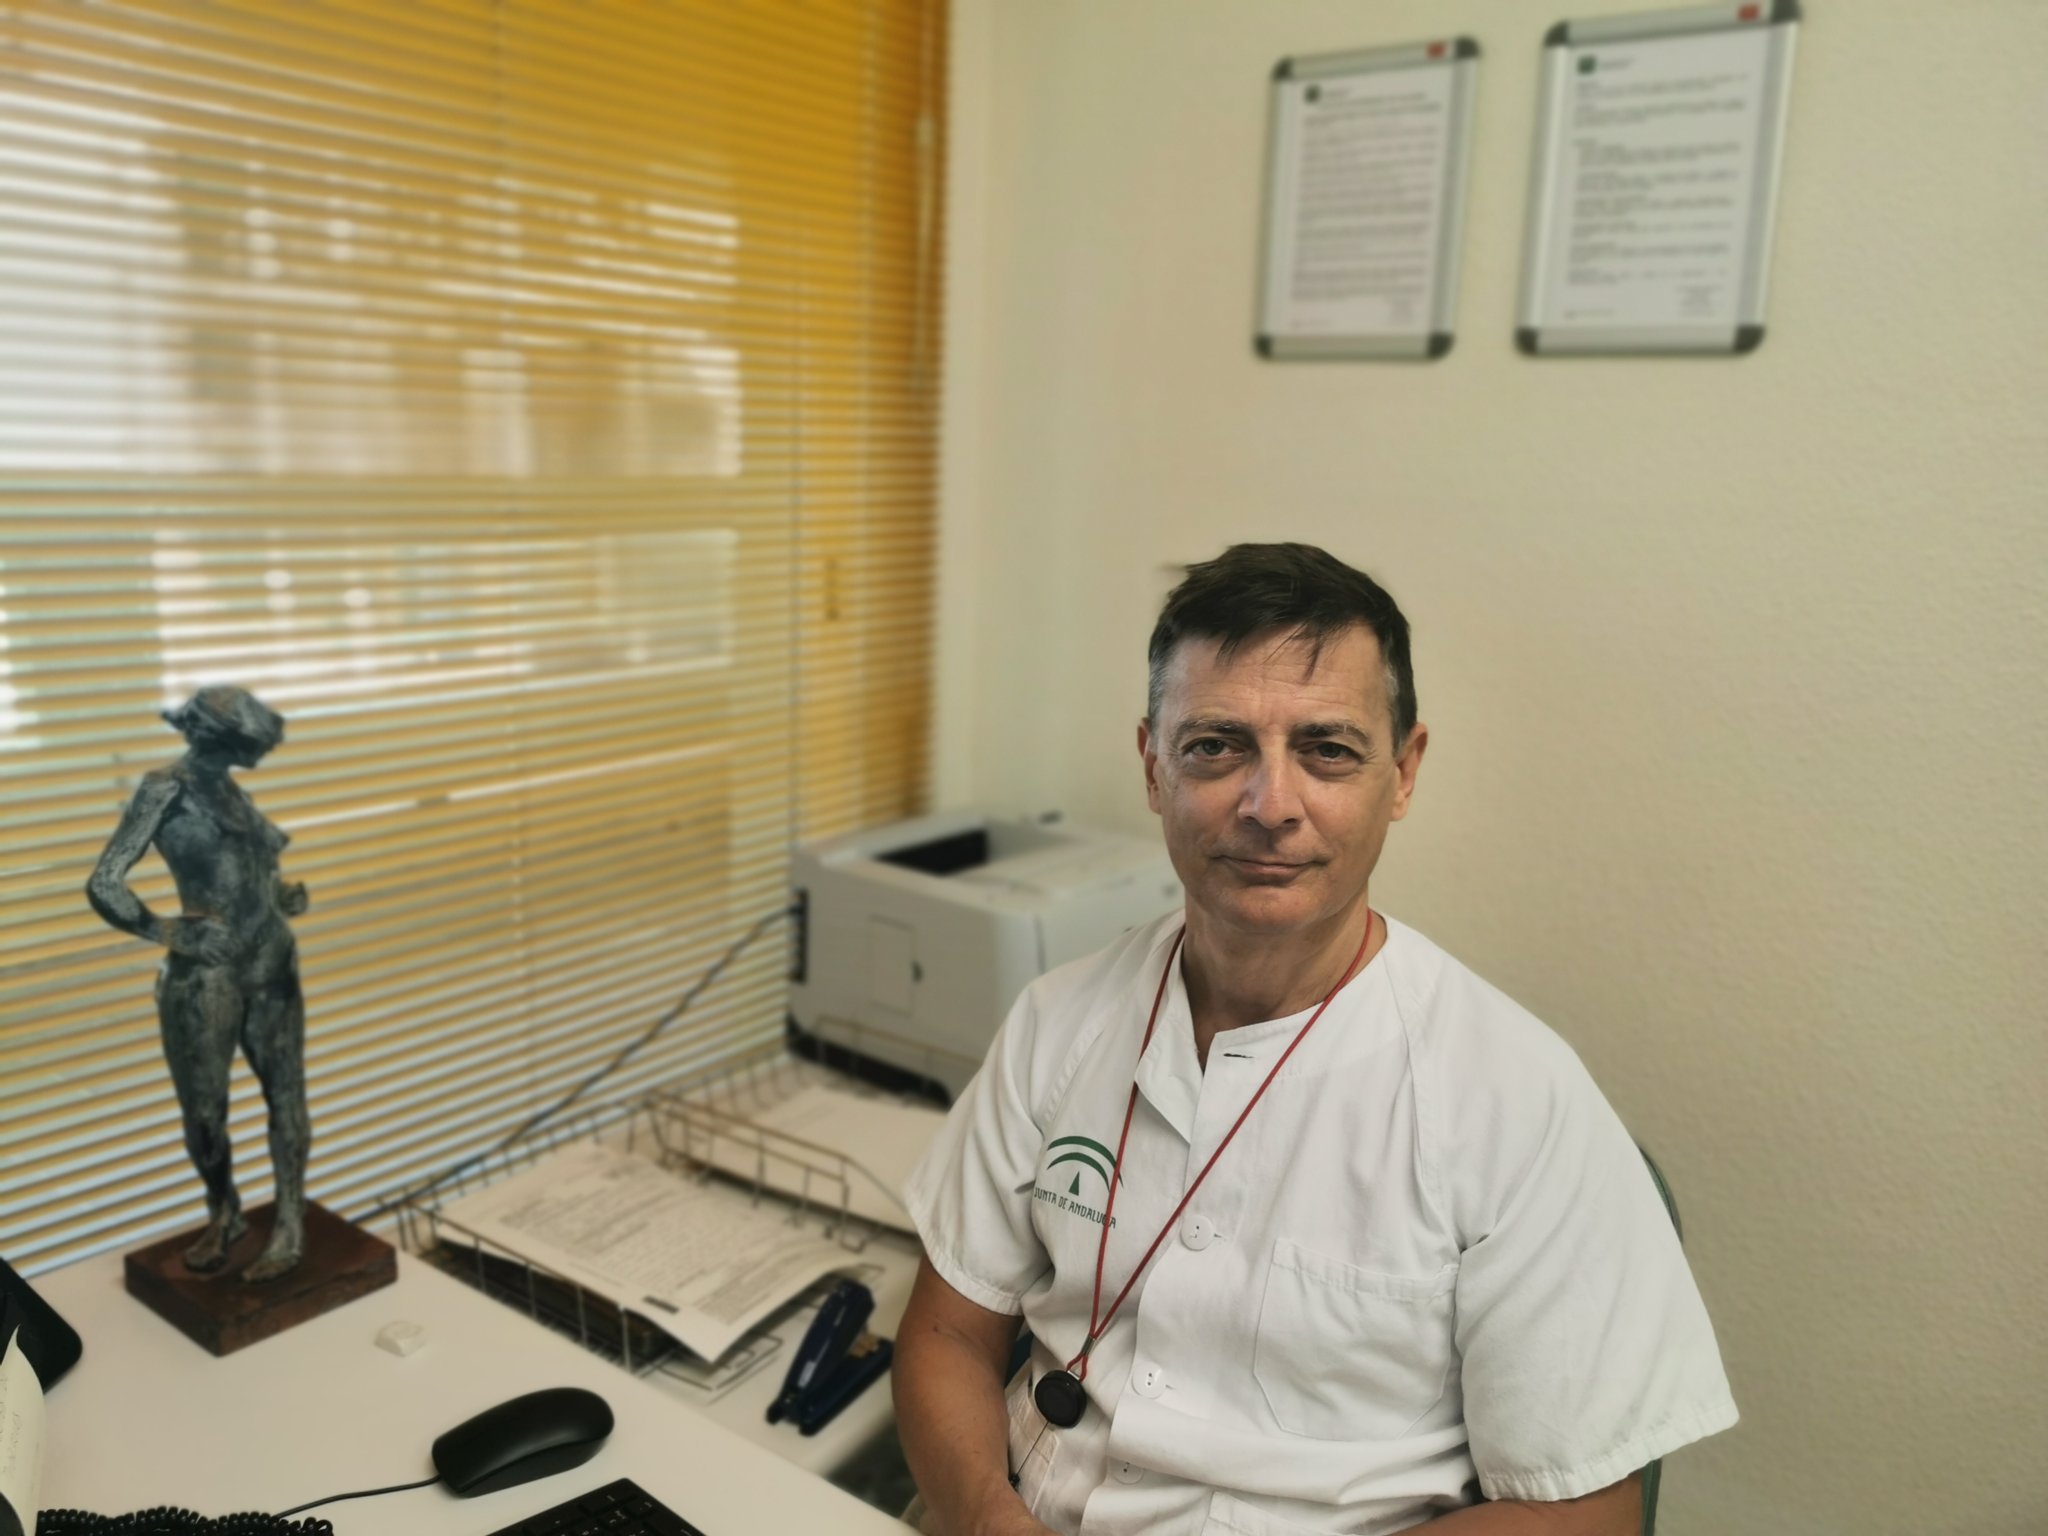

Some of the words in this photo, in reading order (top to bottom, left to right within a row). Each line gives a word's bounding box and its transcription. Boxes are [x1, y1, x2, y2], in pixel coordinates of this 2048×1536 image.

[1034, 1187, 1057, 1204] JUNTA
[1058, 1196, 1069, 1209] DE
[1068, 1201, 1117, 1229] ANDALUCA
